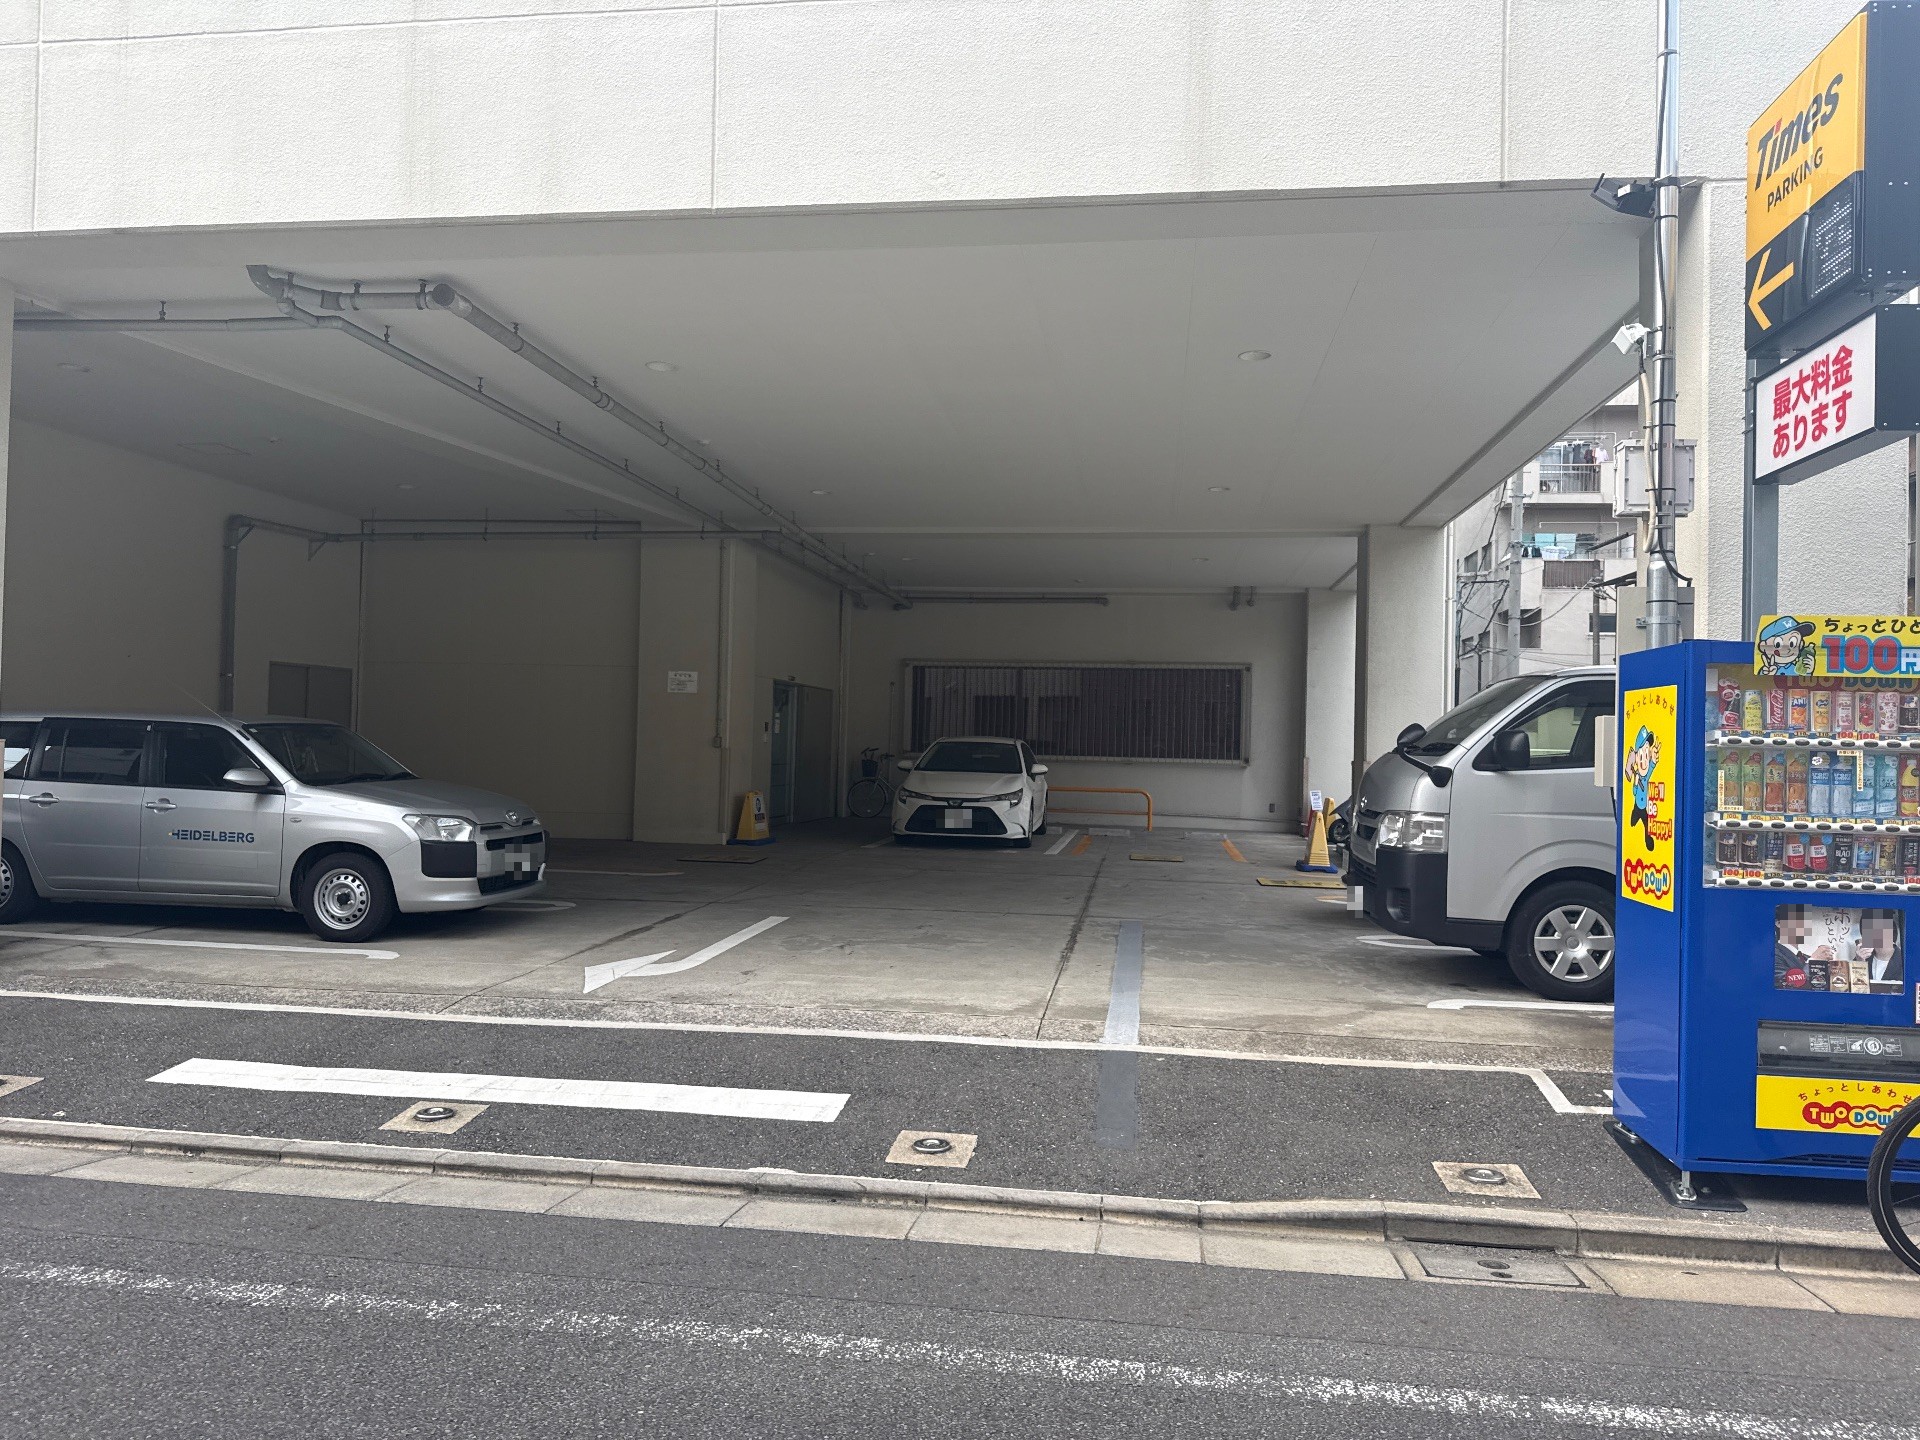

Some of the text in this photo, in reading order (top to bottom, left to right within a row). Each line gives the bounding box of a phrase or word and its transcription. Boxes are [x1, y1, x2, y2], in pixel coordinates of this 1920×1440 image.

[1754, 73, 1844, 191] Times
[1767, 146, 1823, 213] PARKING
[1773, 344, 1853, 421] 最大料金
[1772, 389, 1853, 458] あります
[1648, 801, 1658, 817] Be
[170, 829, 255, 843] HEIDELBERG
[1648, 818, 1672, 840] Happy!
[1626, 863, 1669, 894] TWO DOWN
[1788, 973, 1805, 983] NEW!
[1798, 1082, 1913, 1104] ちょっとしあわせ
[1808, 1105, 1849, 1125] TWO
